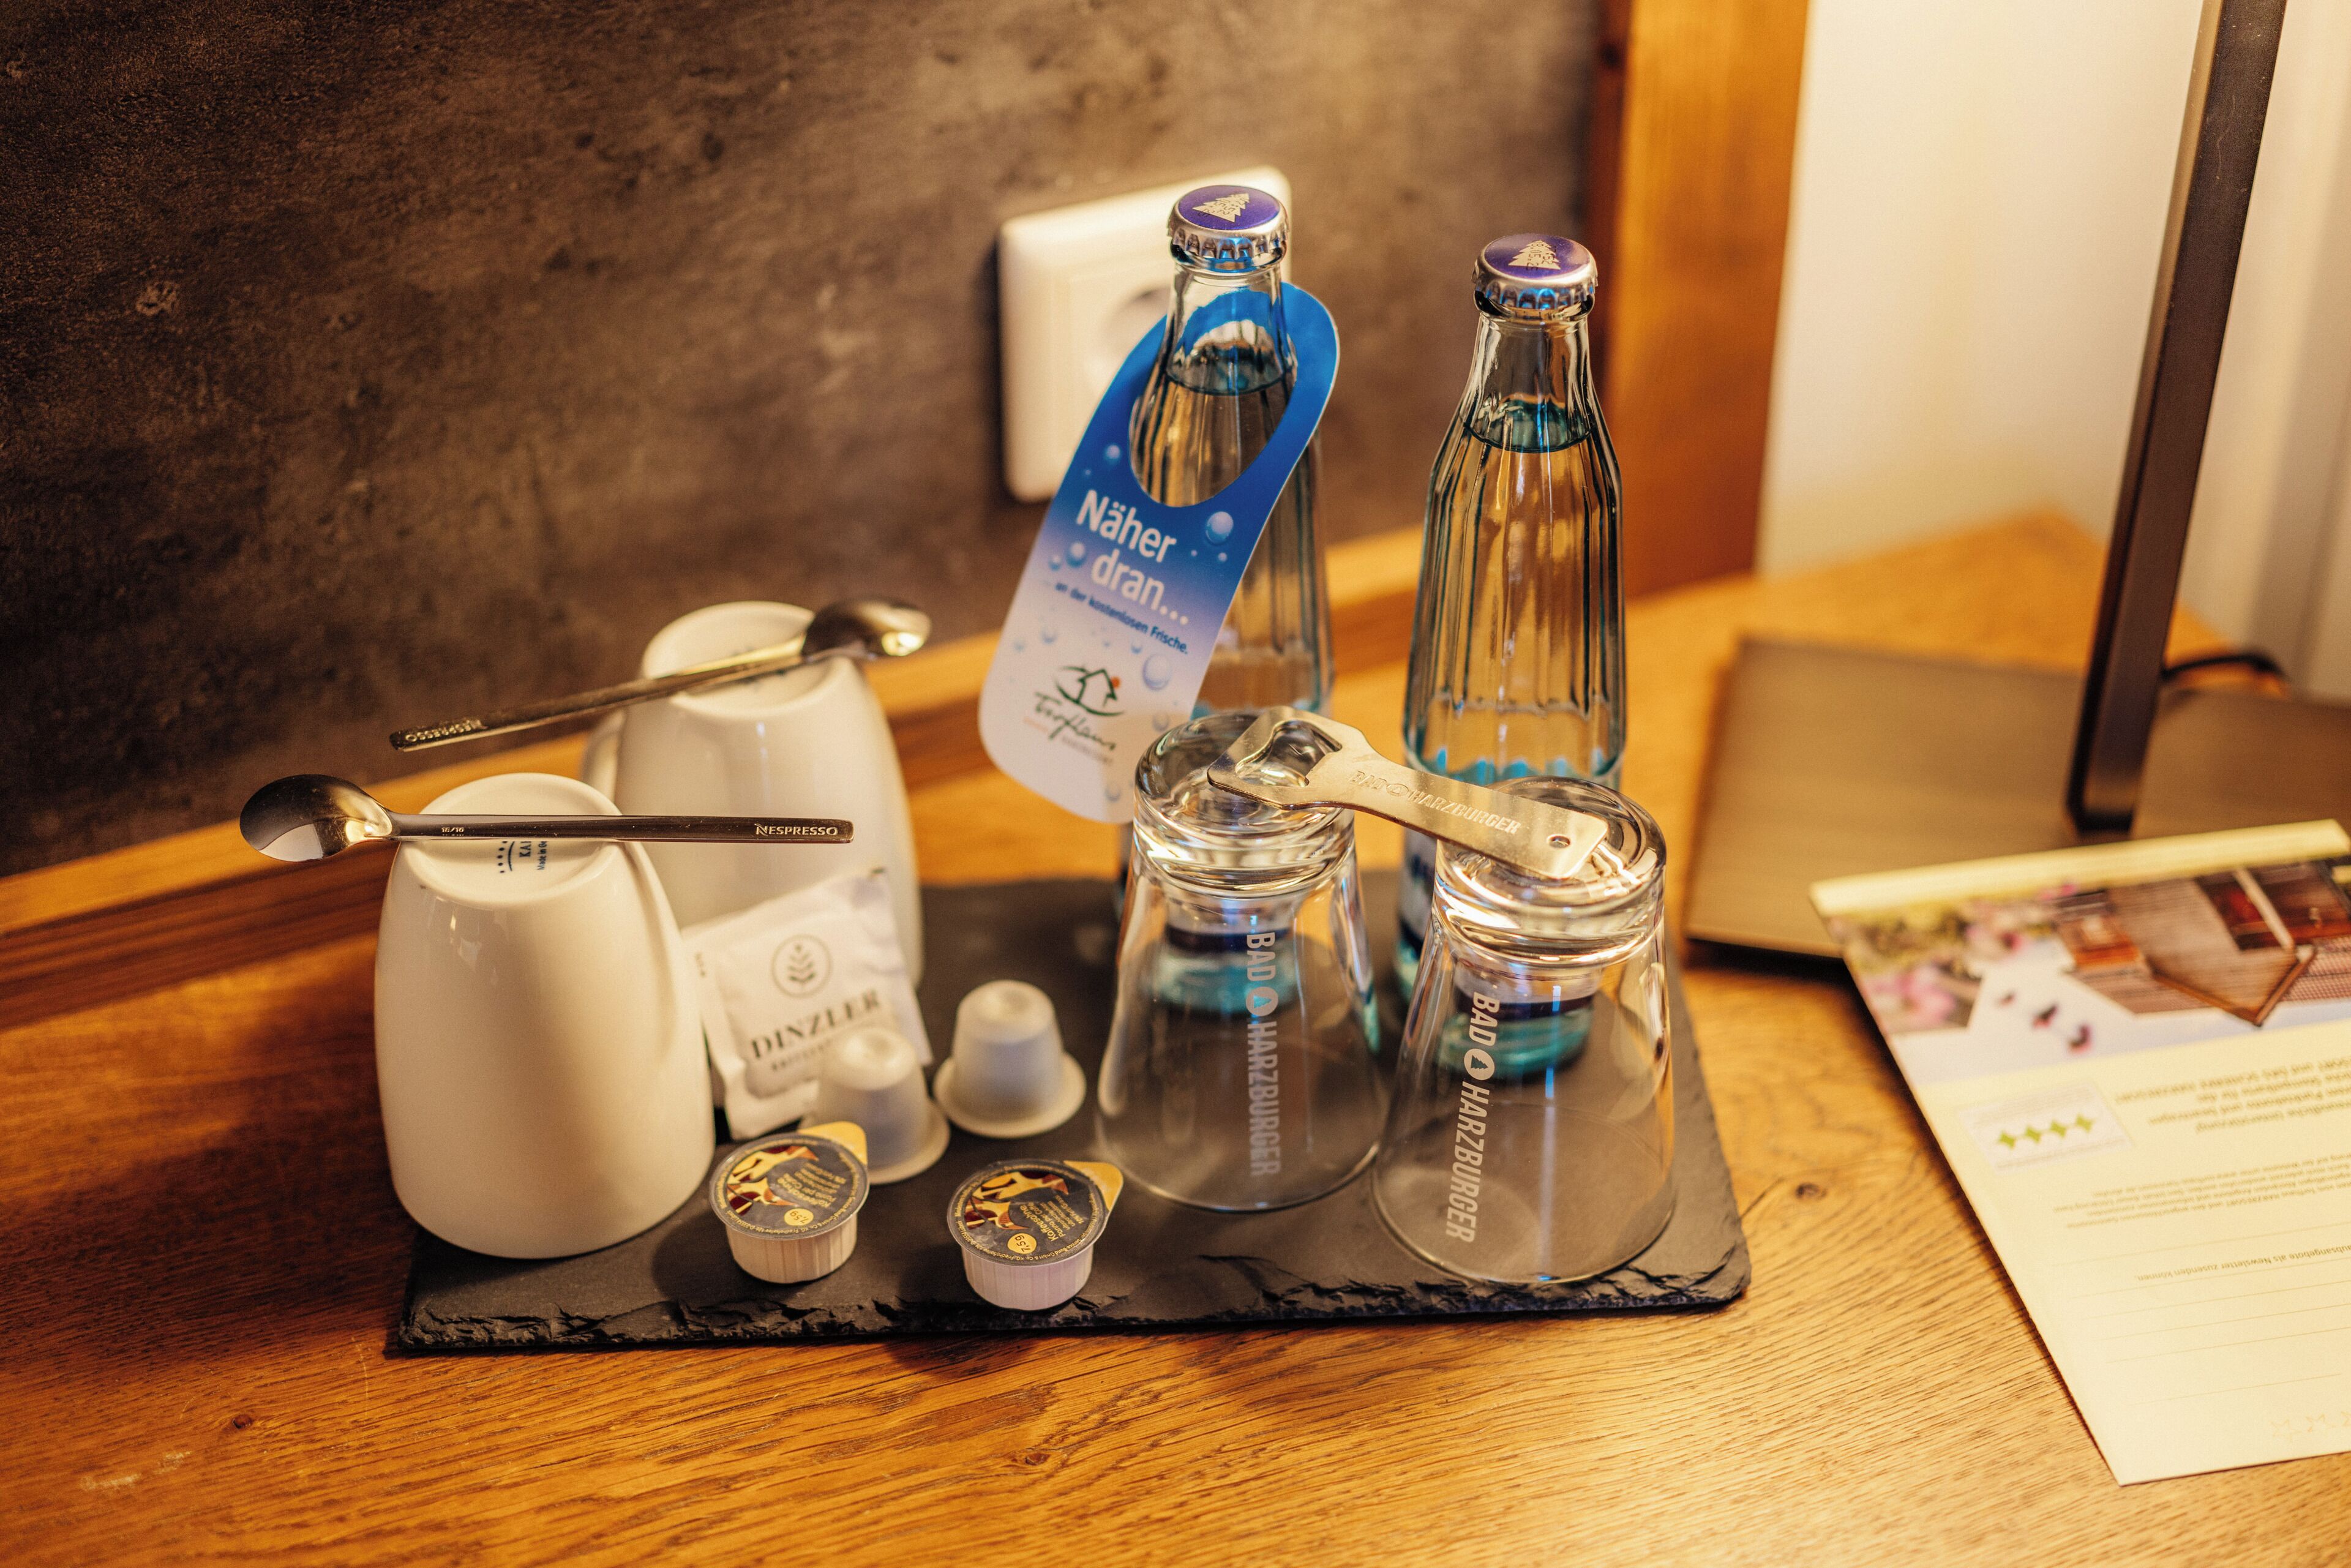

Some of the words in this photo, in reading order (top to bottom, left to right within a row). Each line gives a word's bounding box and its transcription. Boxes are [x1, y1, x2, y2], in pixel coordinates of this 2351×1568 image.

[1076, 489, 1177, 563] Näher
[1090, 549, 1189, 626] dran...
[1055, 581, 1068, 593] an
[1070, 584, 1087, 601] der
[1088, 593, 1149, 634] kostenlosen
[1149, 625, 1189, 655] Frische.
[1349, 769, 1384, 790] BAD
[1406, 789, 1521, 835] HARZBURGER
[754, 823, 839, 836] NESPRESSO
[1246, 931, 1276, 981] BAD
[751, 988, 882, 1060] DINZLER
[1469, 991, 1501, 1045] BAD
[1248, 1023, 1281, 1178] HARZBURGER
[1446, 1081, 1490, 1243] HARZBURGER
[1020, 1204, 1059, 1242] Kaffeesahne
[1041, 1214, 1053, 1222] per
[1049, 1221, 1067, 1237] Panna
[1014, 1234, 1032, 1253] 7,5g
[2220, 1256, 2272, 1270] Newsletter
[2273, 1254, 2287, 1263] als
[2174, 1263, 2218, 1277] zusenden
